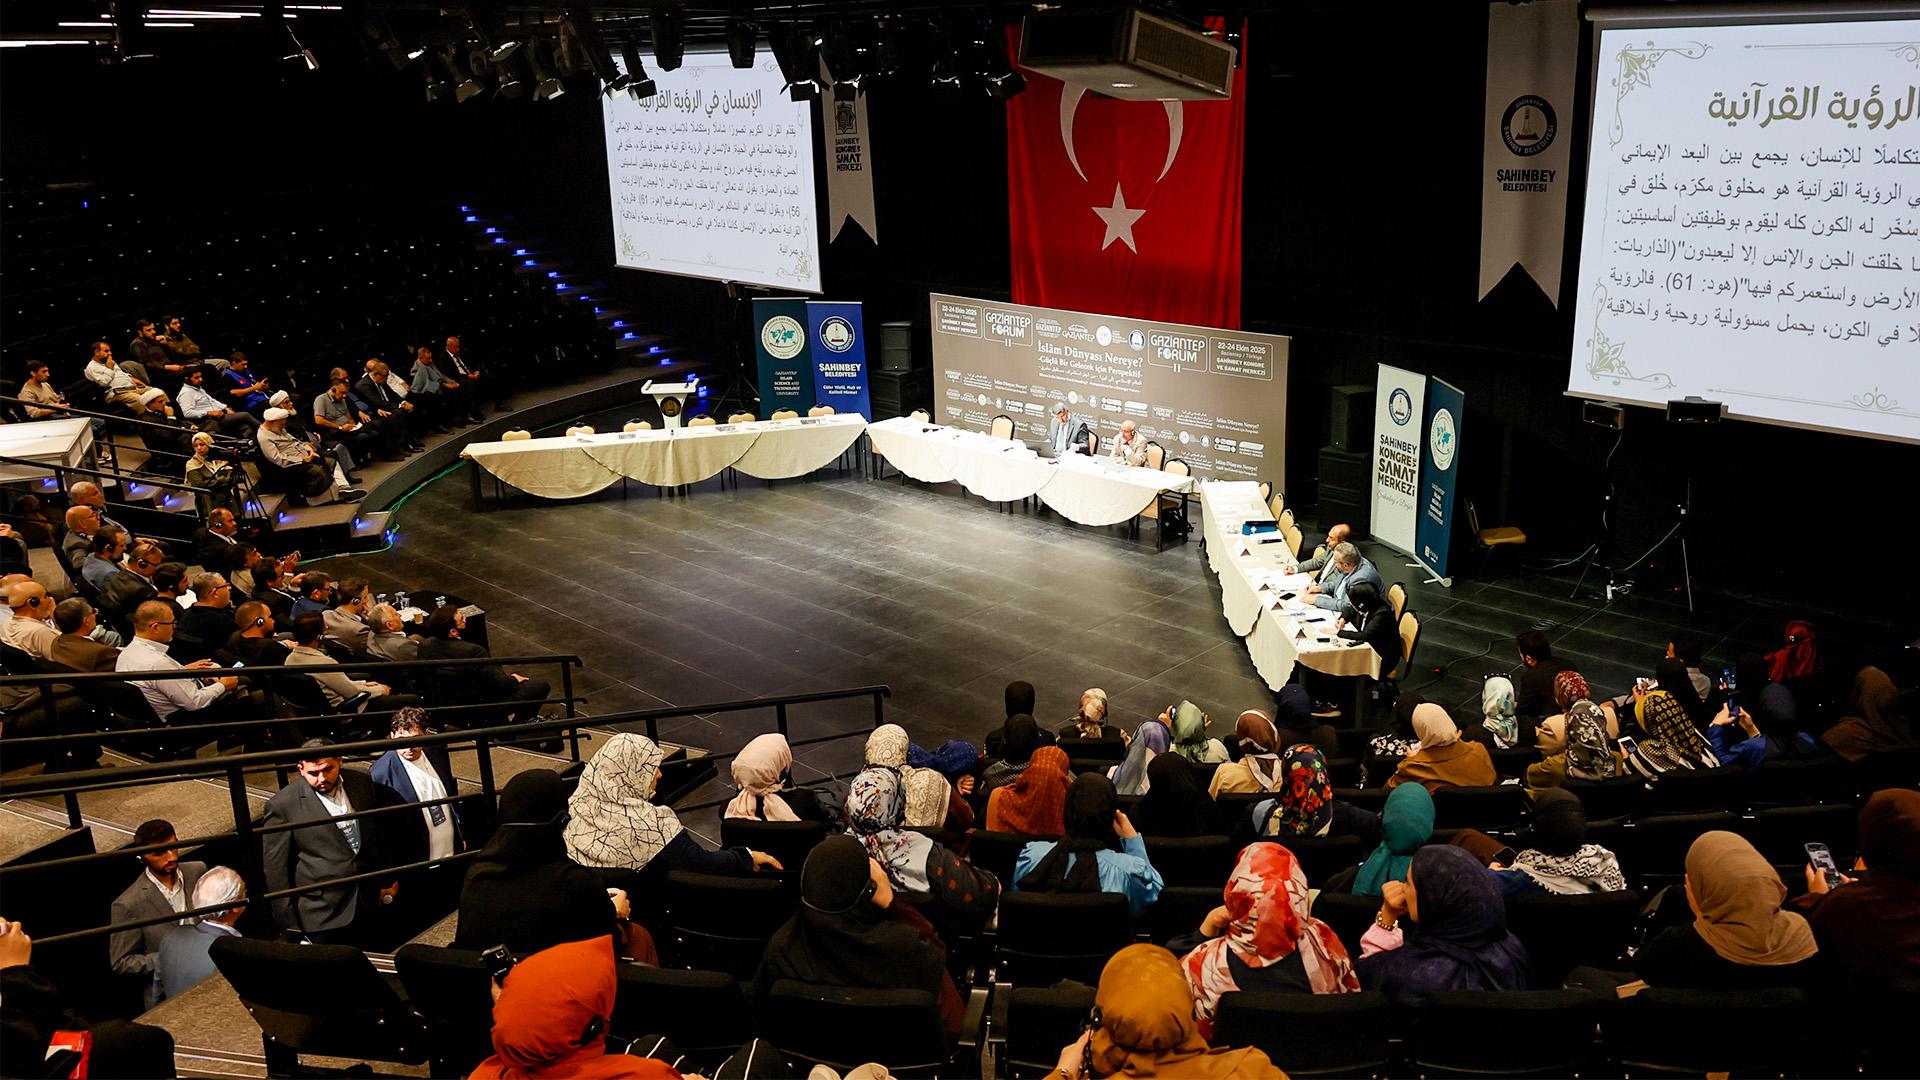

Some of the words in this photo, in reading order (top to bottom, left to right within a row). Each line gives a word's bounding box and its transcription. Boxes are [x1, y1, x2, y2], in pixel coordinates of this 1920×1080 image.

[674, 89, 702, 114] الرؤية
[705, 90, 720, 118] في
[723, 89, 762, 116] الإنسان
[1708, 82, 1820, 128] القرآنية
[836, 153, 861, 163] SANAT
[1622, 144, 1670, 164] الإيماني
[1681, 144, 1710, 162] البعد
[1720, 149, 1742, 164] بين
[1752, 152, 1788, 168] يجمع
[1801, 147, 1861, 168] للإنسان،
[1873, 144, 1920, 165] تكاملًا
[1496, 168, 1556, 182] ŞAHİNBEY
[1618, 174, 1636, 196] في
[1719, 177, 1765, 198] مخلوق
[1772, 184, 1790, 200] هو
[1797, 179, 1848, 202] القرآنية
[1855, 182, 1902, 204] الرؤية
[1616, 204, 1676, 224] أساسيتين:
[1681, 209, 1740, 231] بوظيفتين
[1744, 212, 1779, 233] ليقوم
[1784, 213, 1807, 230] كله
[1812, 216, 1852, 236] الكون
[1859, 217, 1874, 234] له
[1741, 244, 1756, 266] إلا
[1763, 248, 1814, 269] والإنس
[1820, 250, 1854, 270] الجن
[1862, 252, 1903, 271] خلقت
[1610, 266, 1654, 288] فالرؤية
[1777, 281, 1856, 308] واستعمركم
[986, 312, 1030, 328] GAZİANTEP
[1665, 303, 1708, 326] روحية
[1714, 308, 1770, 330] مسؤولية
[1777, 313, 1815, 336] يحمل
[992, 324, 1024, 338] FORUM
[1823, 320, 1870, 341] الكون،
[1877, 325, 1900, 348] في
[1150, 334, 1205, 352] GAZİANTEP
[1218, 342, 1236, 350] 22-24
[1236, 344, 1250, 352] Ekim
[1250, 346, 1266, 354] 2025
[1064, 346, 1102, 362] Dünyası
[1105, 352, 1144, 368] Nereye?
[1158, 348, 1198, 363] FORUM
[1379, 446, 1412, 468] KONGRE
[1378, 458, 1416, 484] SANAT
